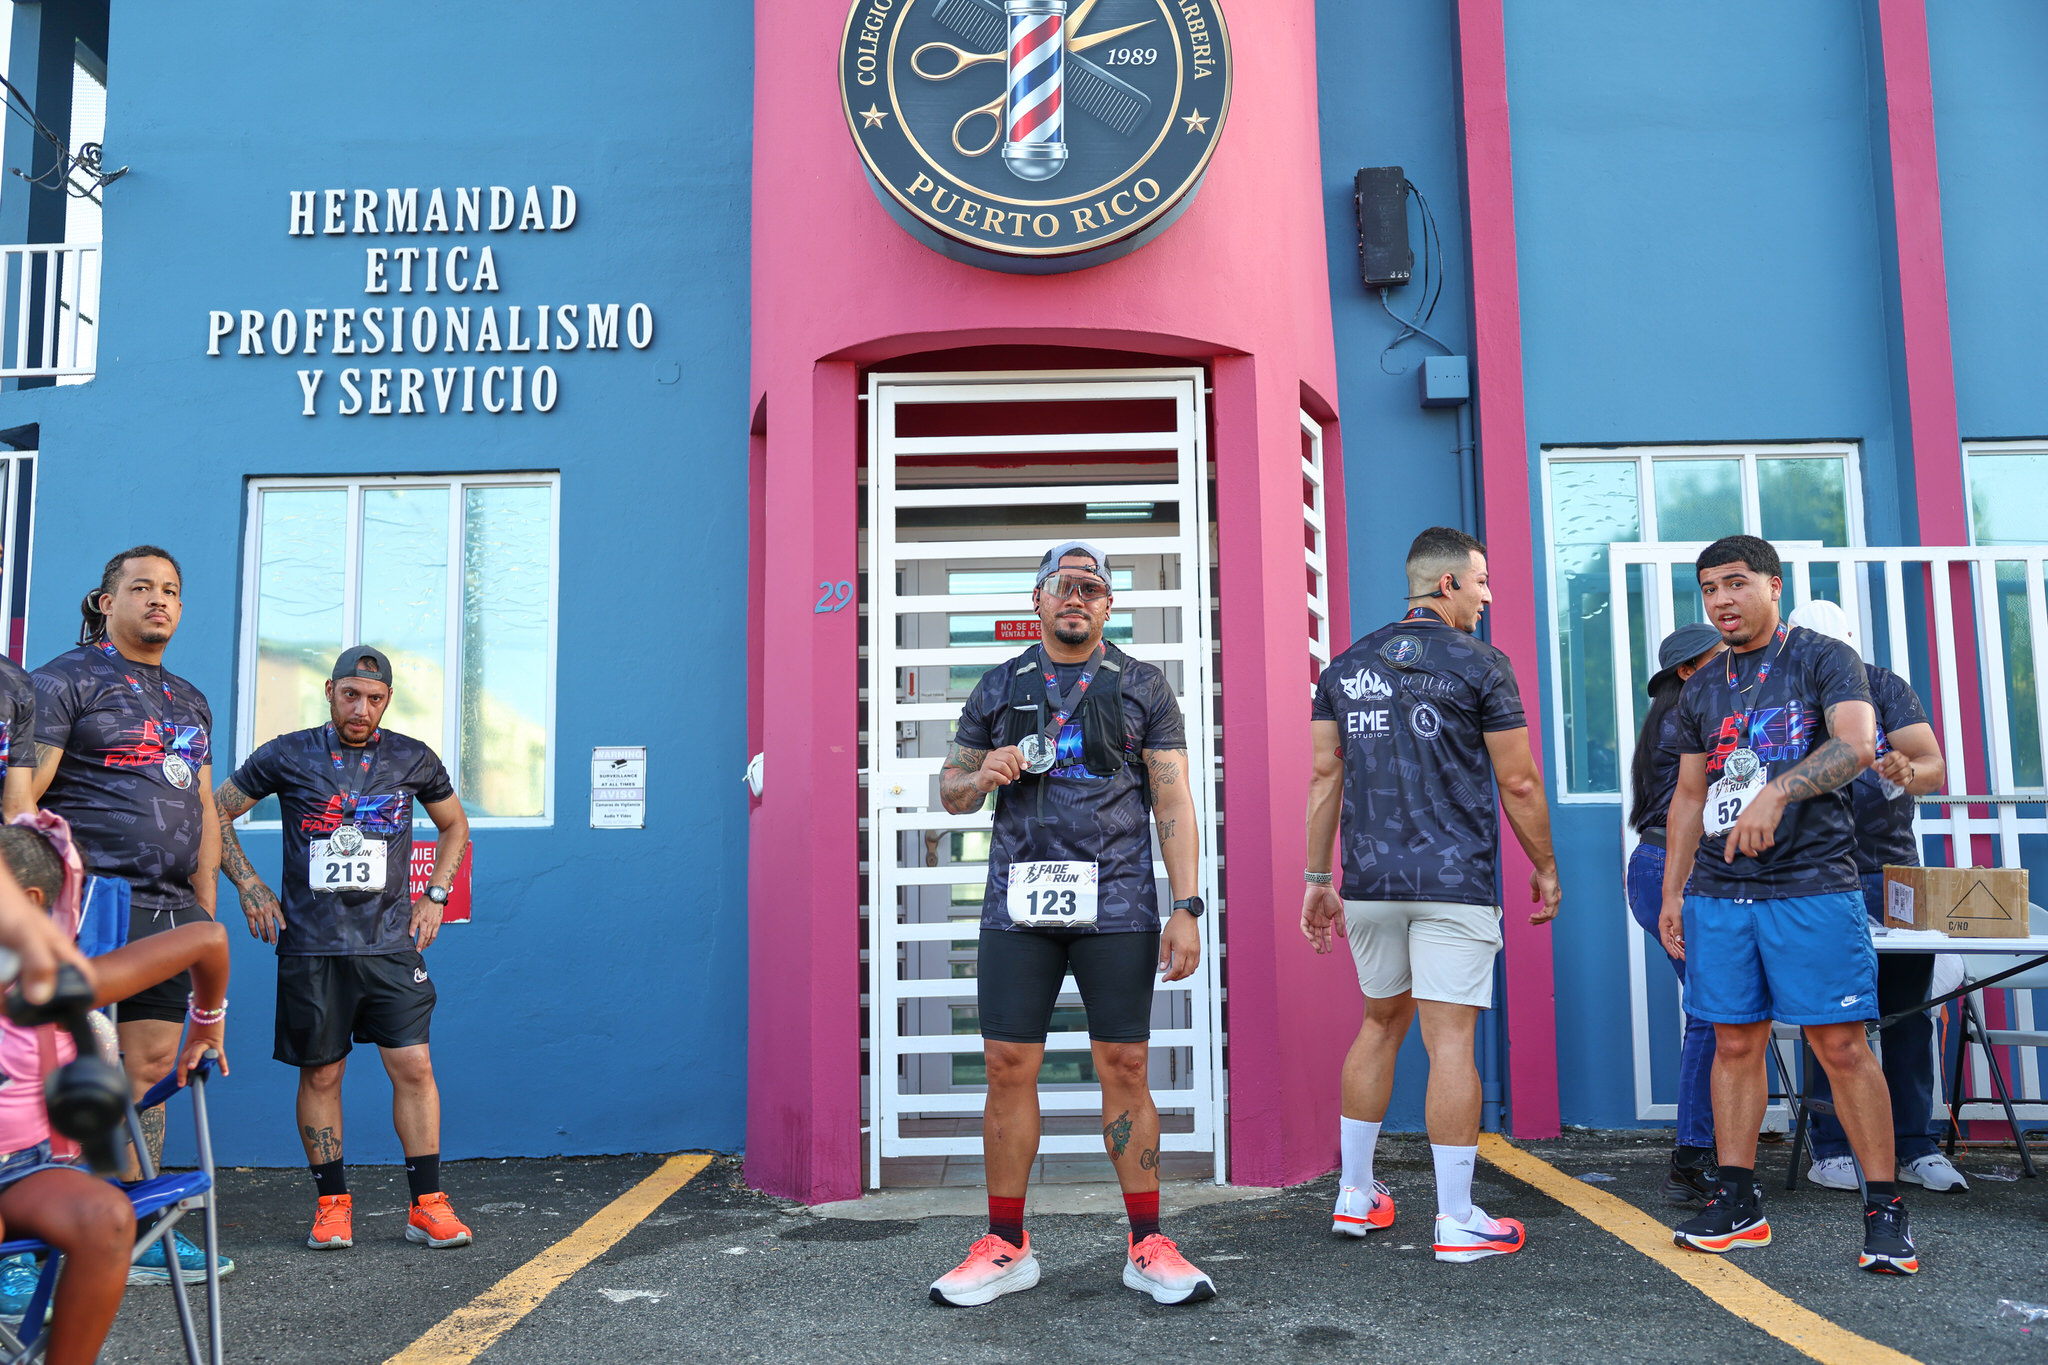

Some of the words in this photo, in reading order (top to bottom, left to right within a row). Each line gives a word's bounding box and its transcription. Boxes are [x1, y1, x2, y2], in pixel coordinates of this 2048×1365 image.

[1105, 47, 1158, 66] 1989
[288, 184, 577, 236] HERMANDAD
[905, 171, 1060, 238] PUERTO
[1070, 177, 1161, 234] RICO
[364, 245, 499, 293] ETICA
[206, 302, 654, 356] PROFESIONALISMO
[297, 369, 324, 415] Y
[339, 365, 558, 415] SERVICIO
[814, 581, 854, 614] 29
[1001, 622, 1013, 631] NO
[1016, 622, 1027, 631] SE
[1030, 622, 1042, 631] PE
[1347, 710, 1390, 733] EME
[595, 750, 642, 759] WARNING
[600, 790, 637, 800] AVISO
[1729, 780, 1751, 793] RUN
[1718, 797, 1742, 825] 52
[326, 862, 370, 883] 213
[1038, 864, 1069, 874] FADE
[1053, 874, 1079, 883] RUN
[1026, 890, 1077, 916] 123
[1948, 921, 1969, 931] C/NO
